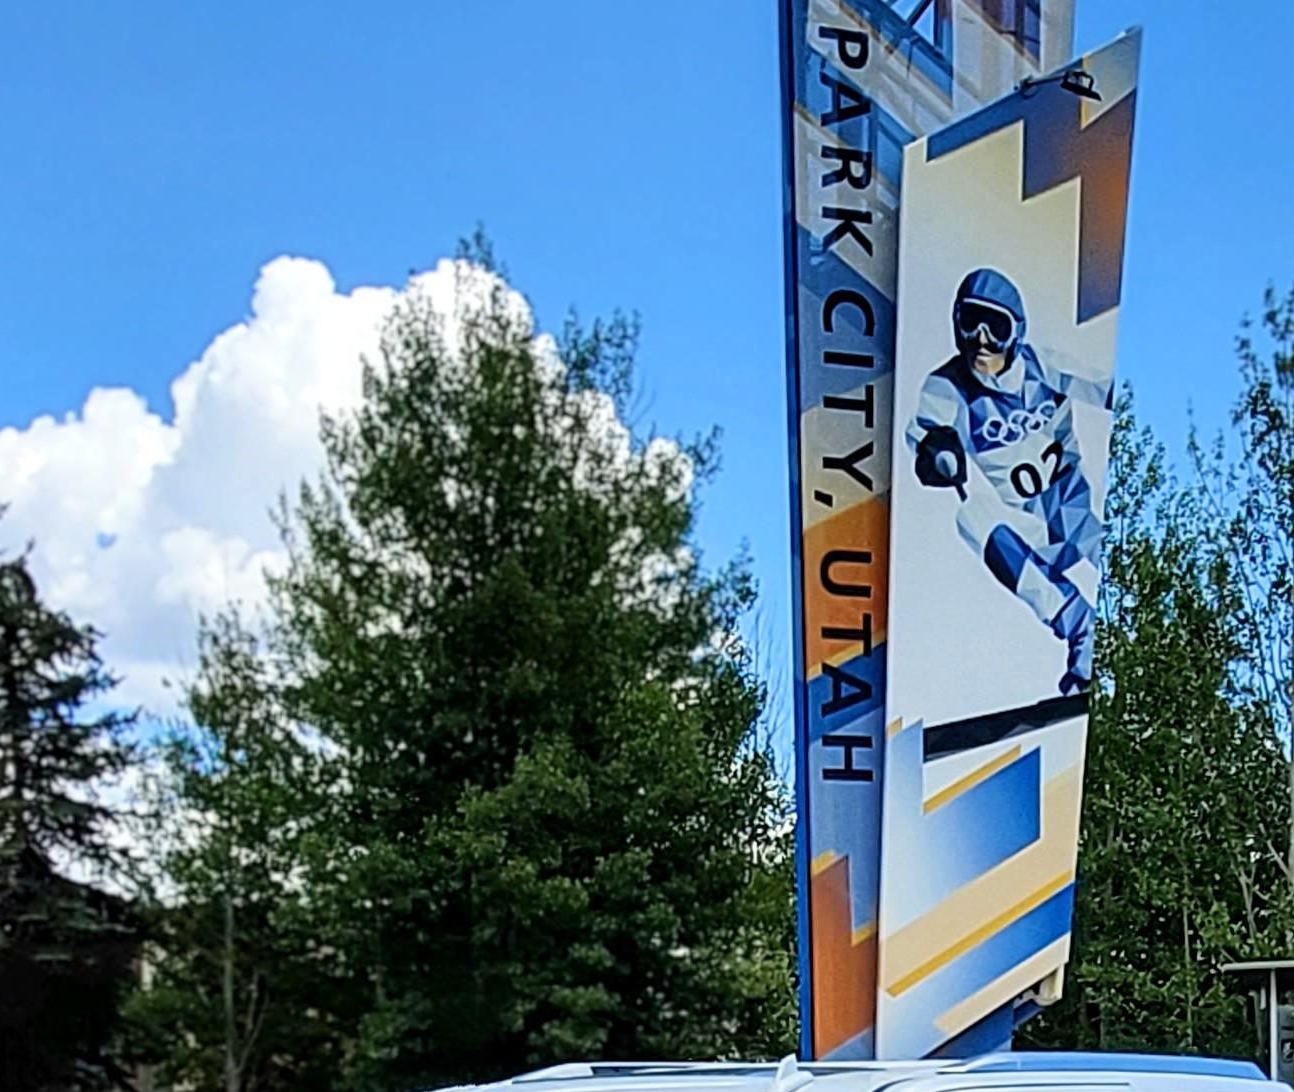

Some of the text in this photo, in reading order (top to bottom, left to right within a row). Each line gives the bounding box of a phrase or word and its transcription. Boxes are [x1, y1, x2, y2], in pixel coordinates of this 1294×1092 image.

[813, 25, 876, 783] PARK CITY, UTAH
[1009, 440, 1073, 499] 02
